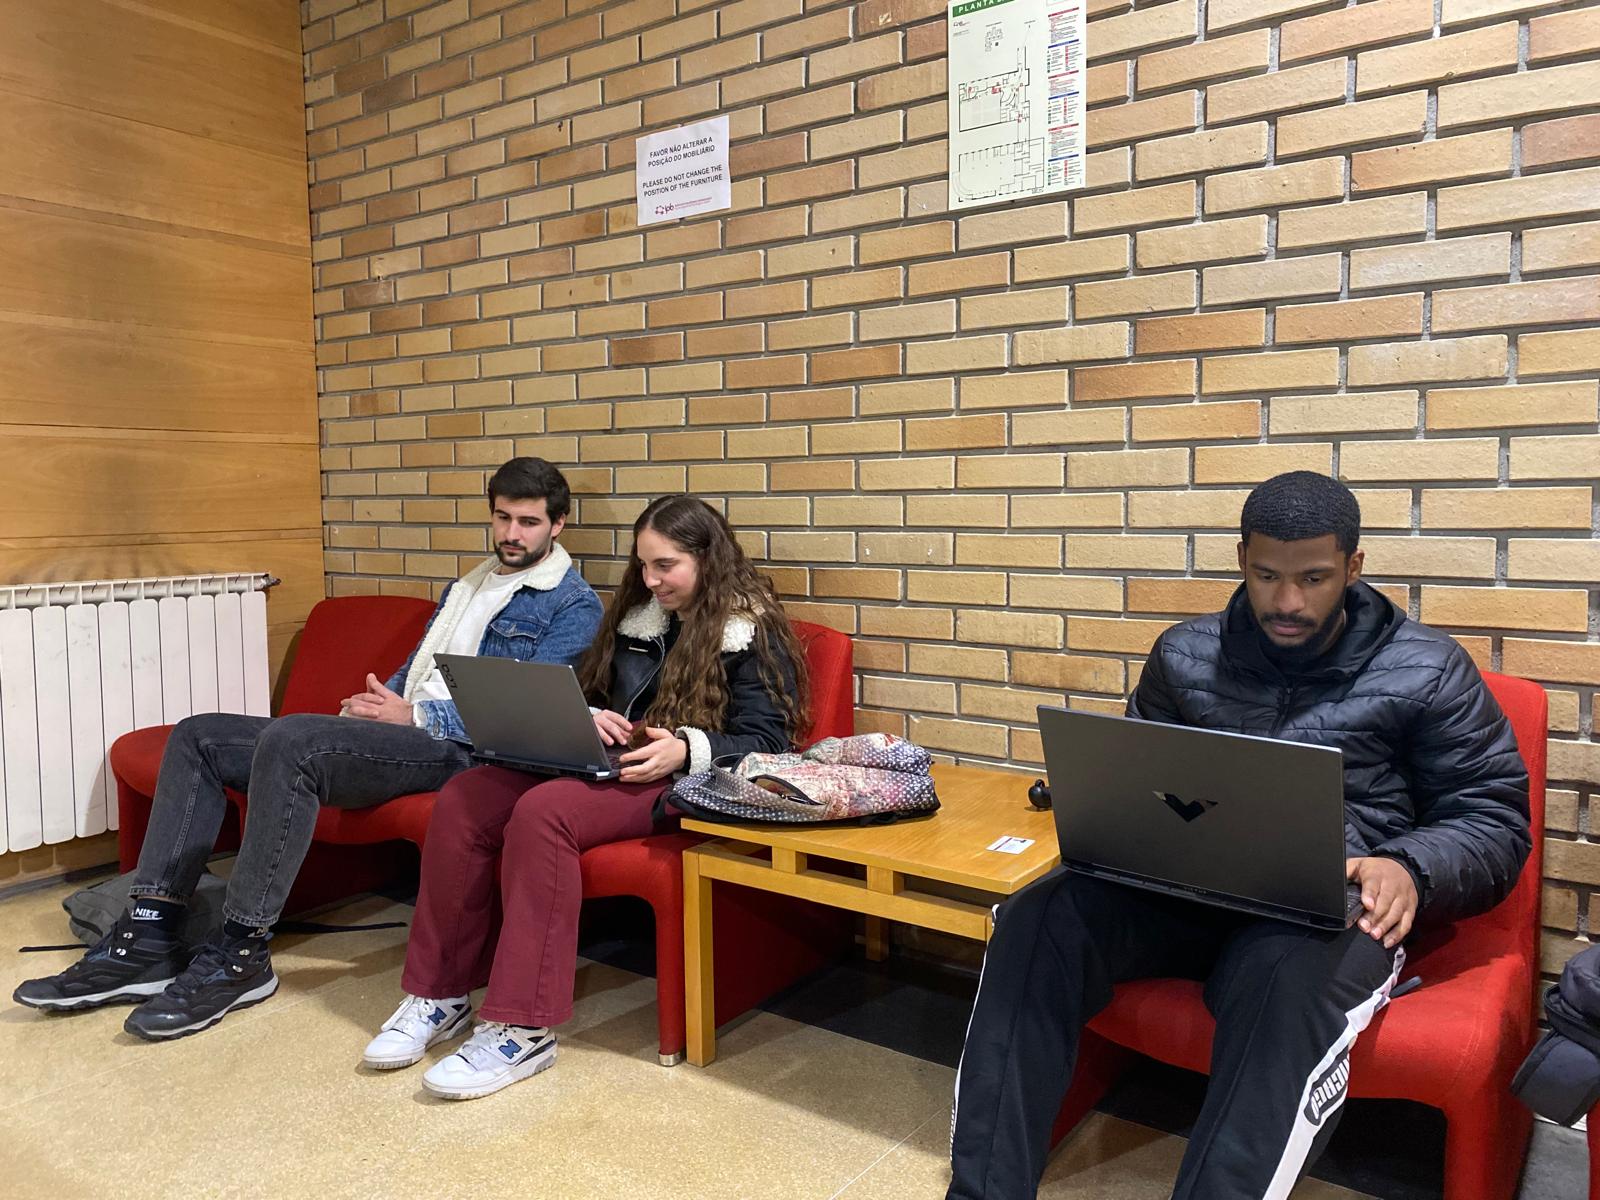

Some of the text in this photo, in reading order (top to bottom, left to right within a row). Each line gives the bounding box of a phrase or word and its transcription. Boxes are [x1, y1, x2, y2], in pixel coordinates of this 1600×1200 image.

[958, 0, 994, 13] PLANTA
[648, 156, 672, 168] POSIÇÃO
[682, 144, 716, 158] MOBILIÁRIO
[650, 148, 668, 158] FAVOR
[670, 144, 682, 154] NÃO
[682, 138, 708, 150] ALTERAR
[642, 178, 664, 188] PLEASE
[686, 168, 710, 178] CHANGE
[710, 164, 722, 172] THE
[644, 186, 668, 196] POSITION
[690, 174, 724, 186] FURNITURE
[134, 905, 160, 919] NIKE
